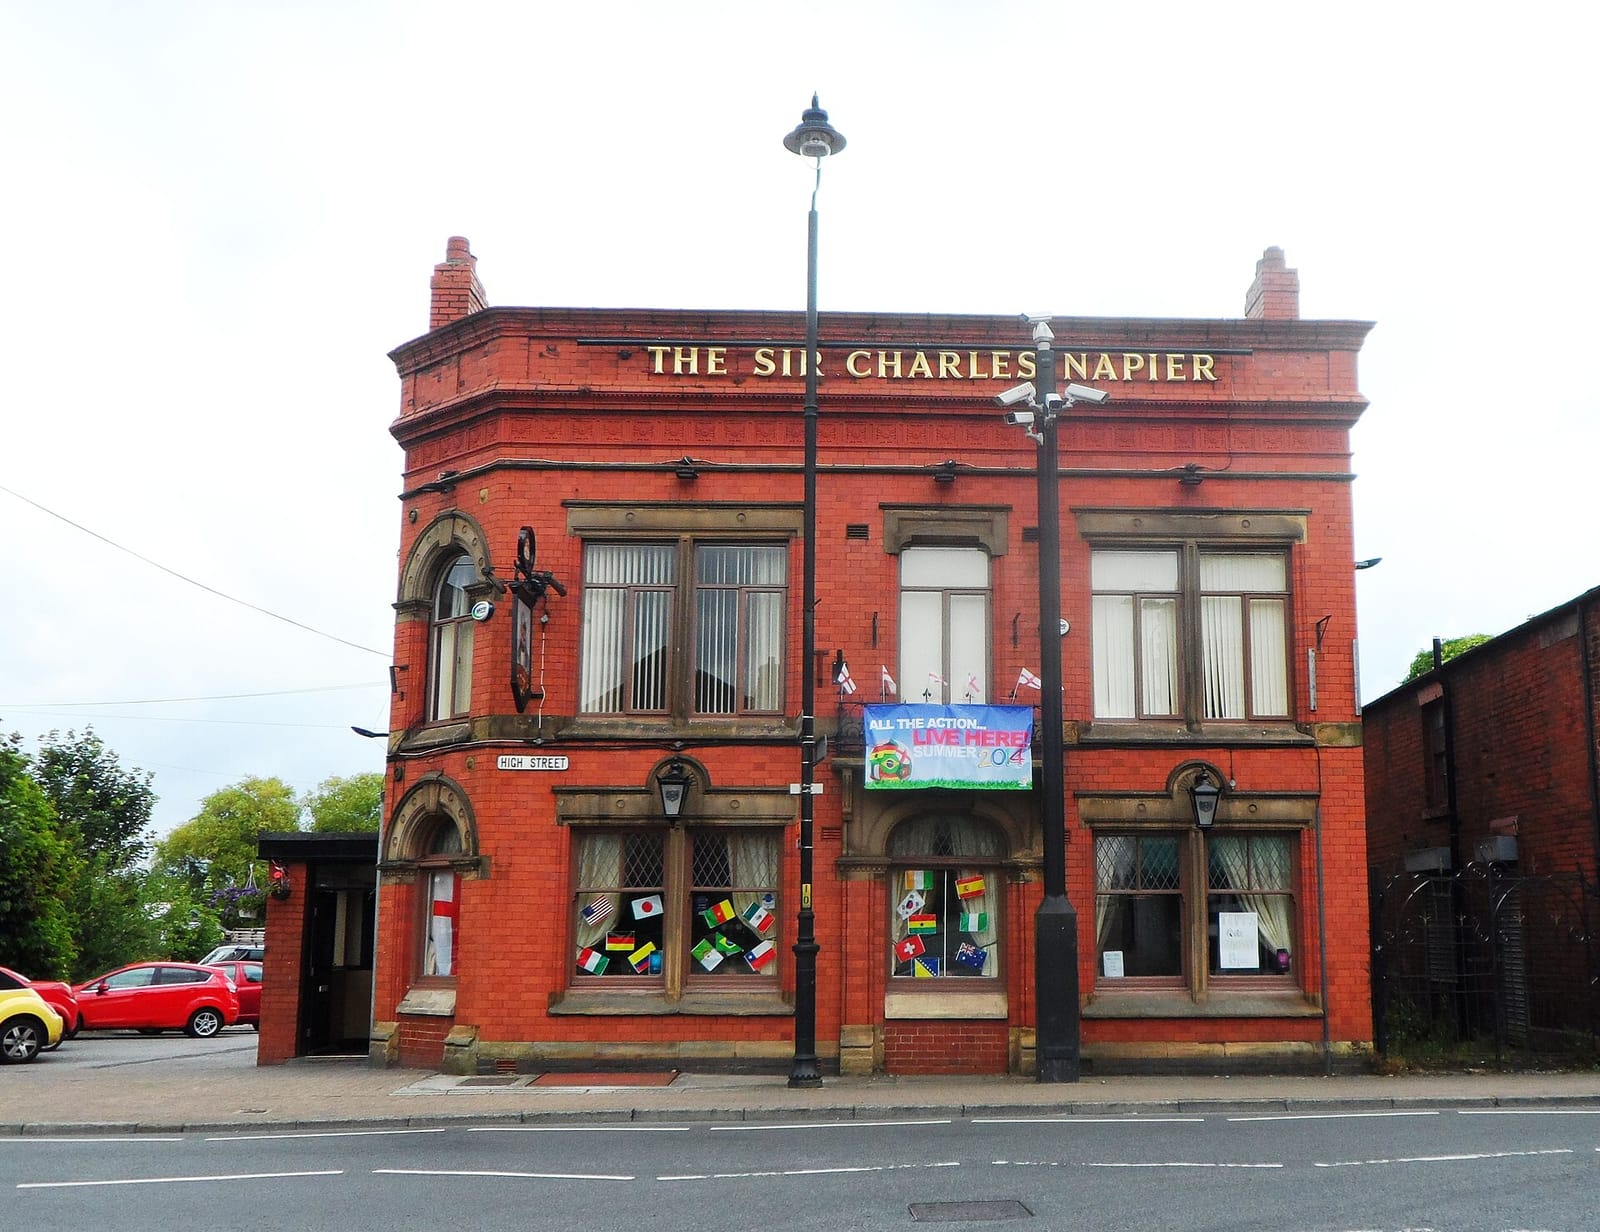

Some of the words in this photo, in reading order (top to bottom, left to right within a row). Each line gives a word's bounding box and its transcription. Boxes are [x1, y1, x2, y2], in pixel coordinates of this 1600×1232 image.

[648, 346, 727, 374] THE
[753, 348, 824, 376] SIR
[846, 350, 1036, 379] CHARLES
[1064, 353, 1218, 381] NAPIER
[869, 719, 895, 730] ALL
[897, 718, 924, 730] THE
[913, 729, 959, 746] LIVE
[965, 731, 1029, 748] HERE!
[913, 745, 977, 759] SUMMER
[501, 757, 523, 768] HIGH
[530, 757, 566, 769] STREET
